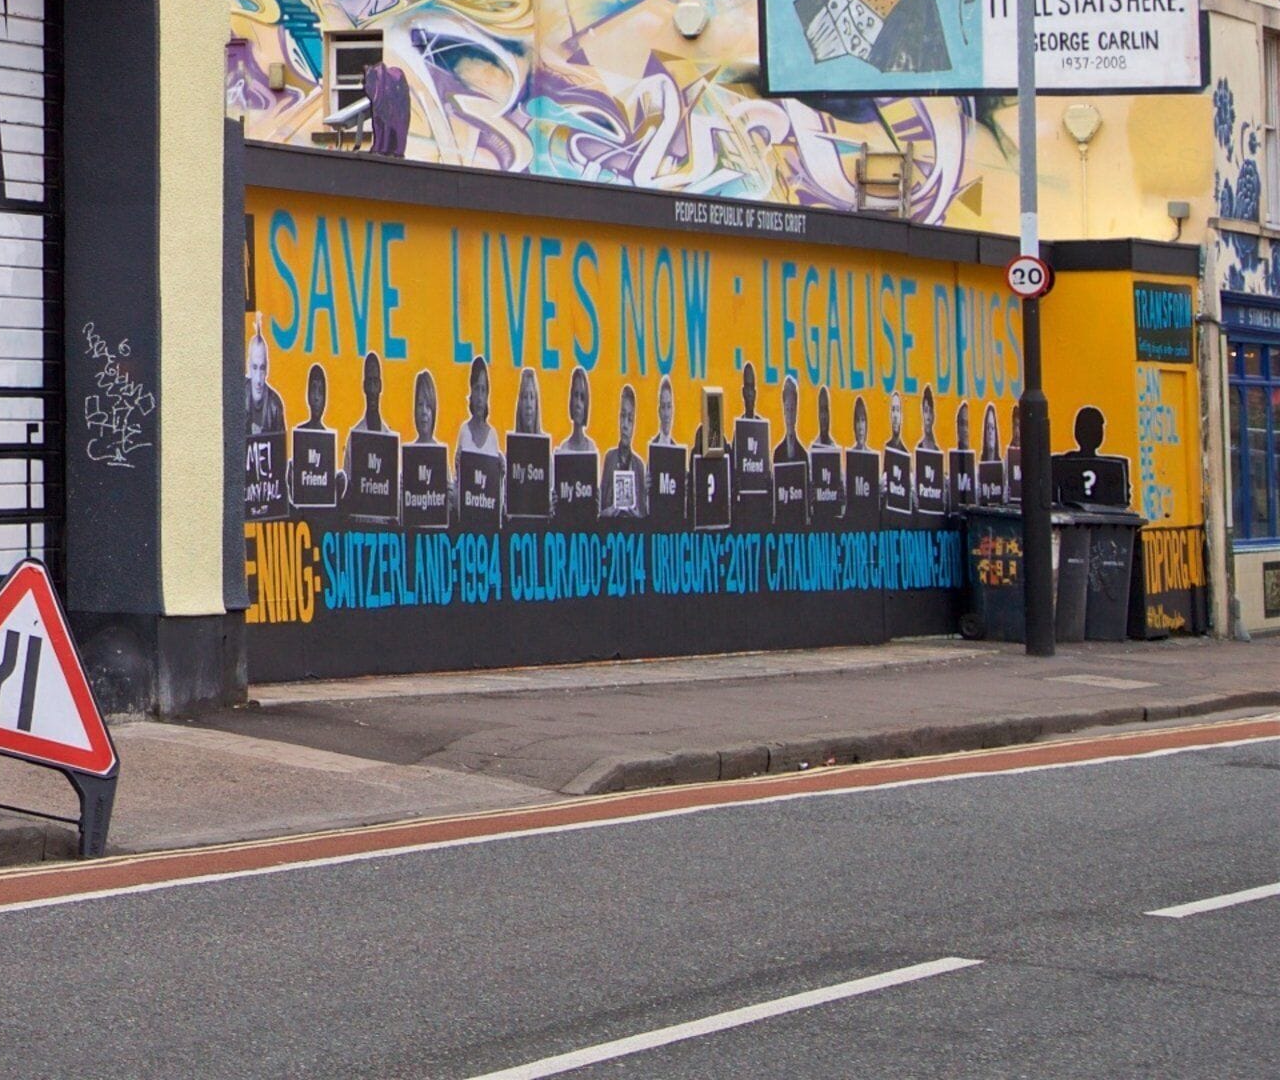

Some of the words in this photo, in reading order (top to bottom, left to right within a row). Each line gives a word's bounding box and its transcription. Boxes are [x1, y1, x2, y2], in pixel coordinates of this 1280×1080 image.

[1098, 30, 1159, 51] CARLIN
[1061, 55, 1128, 71] 1937-2008
[675, 201, 708, 223] PEOPLES
[710, 204, 744, 227] REPUBLIC
[745, 208, 756, 229] OF
[757, 209, 783, 231] STOKES
[784, 213, 807, 234] CROFT
[1012, 267, 1043, 285] 20
[268, 209, 408, 359] SAVE
[451, 226, 601, 372] LIVES
[620, 243, 712, 380] NOW
[762, 258, 919, 394] LEGALISE
[933, 282, 1025, 400] DRUGS
[746, 437, 758, 455] My
[307, 448, 321, 467] My
[367, 453, 382, 473] My
[742, 458, 764, 474] Friend
[301, 471, 328, 486] Friend
[417, 464, 432, 485] My
[474, 469, 488, 489] My
[512, 462, 526, 484] My
[527, 463, 545, 481] Son
[821, 468, 832, 485] My
[924, 464, 935, 483] My
[1081, 469, 1097, 497] ?
[360, 477, 389, 496] Friend
[560, 481, 574, 502] My
[575, 481, 593, 498] Son
[659, 472, 677, 496] Me
[854, 476, 871, 497] Me
[919, 483, 942, 499] Partner
[404, 490, 446, 511] Daughter
[464, 491, 496, 510] Brother
[778, 486, 789, 504] My
[789, 486, 803, 501] Son
[322, 530, 502, 610] SWITZERLAND:1994
[509, 531, 646, 601] COLORADO:2014
[651, 531, 762, 594] URUGUAY:2017
